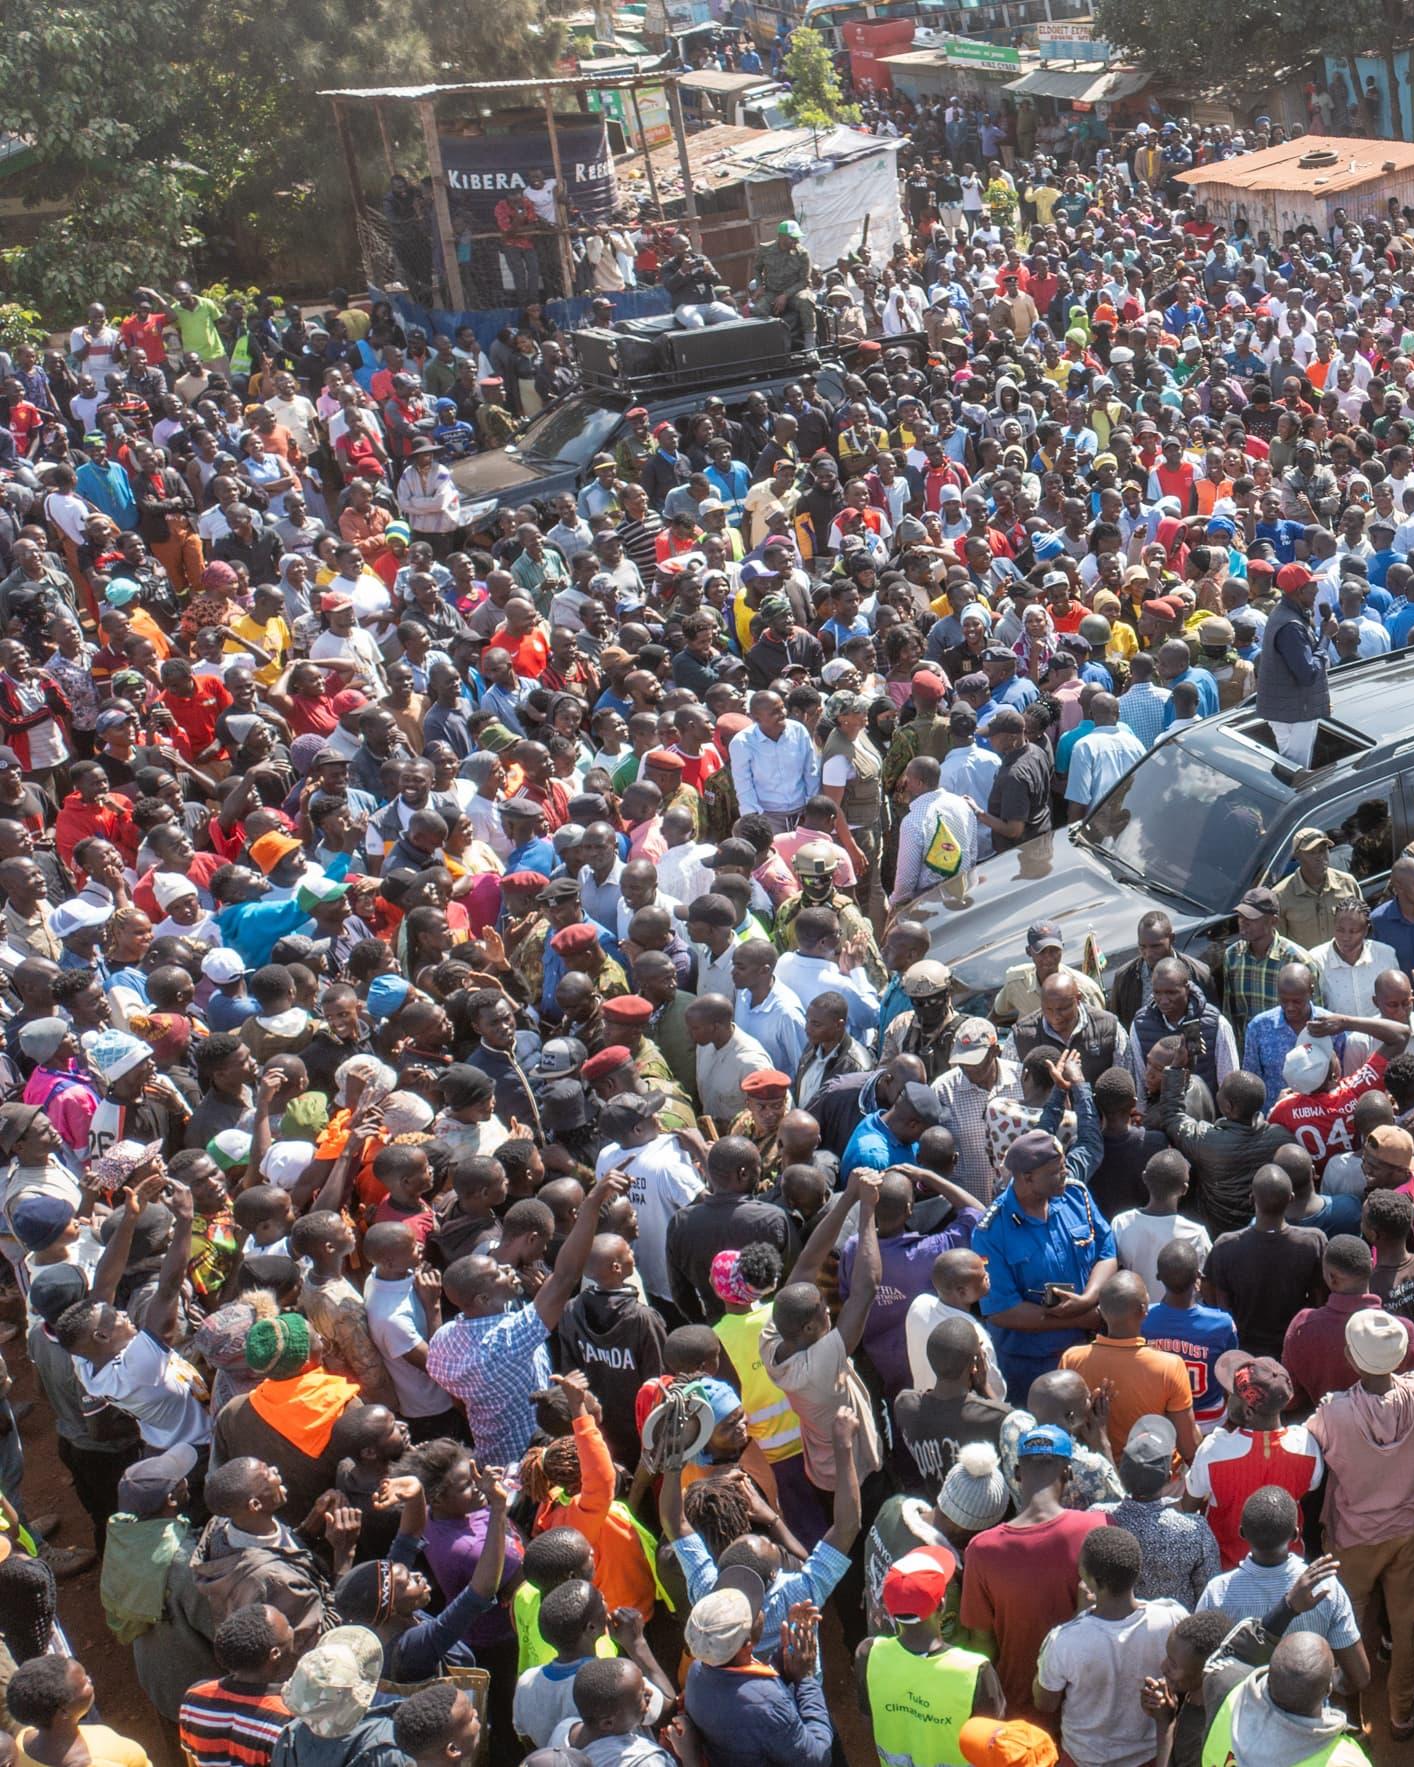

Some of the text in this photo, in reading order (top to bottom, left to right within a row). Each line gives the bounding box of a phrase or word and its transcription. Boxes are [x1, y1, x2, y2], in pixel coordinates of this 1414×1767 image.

[448, 170, 526, 190] KIBERA
[1292, 1106, 1325, 1119] KUBWA
[1295, 1117, 1354, 1161] 04
[907, 1691, 931, 1708] Tuko
[885, 1703, 953, 1725] ClimateWorX
